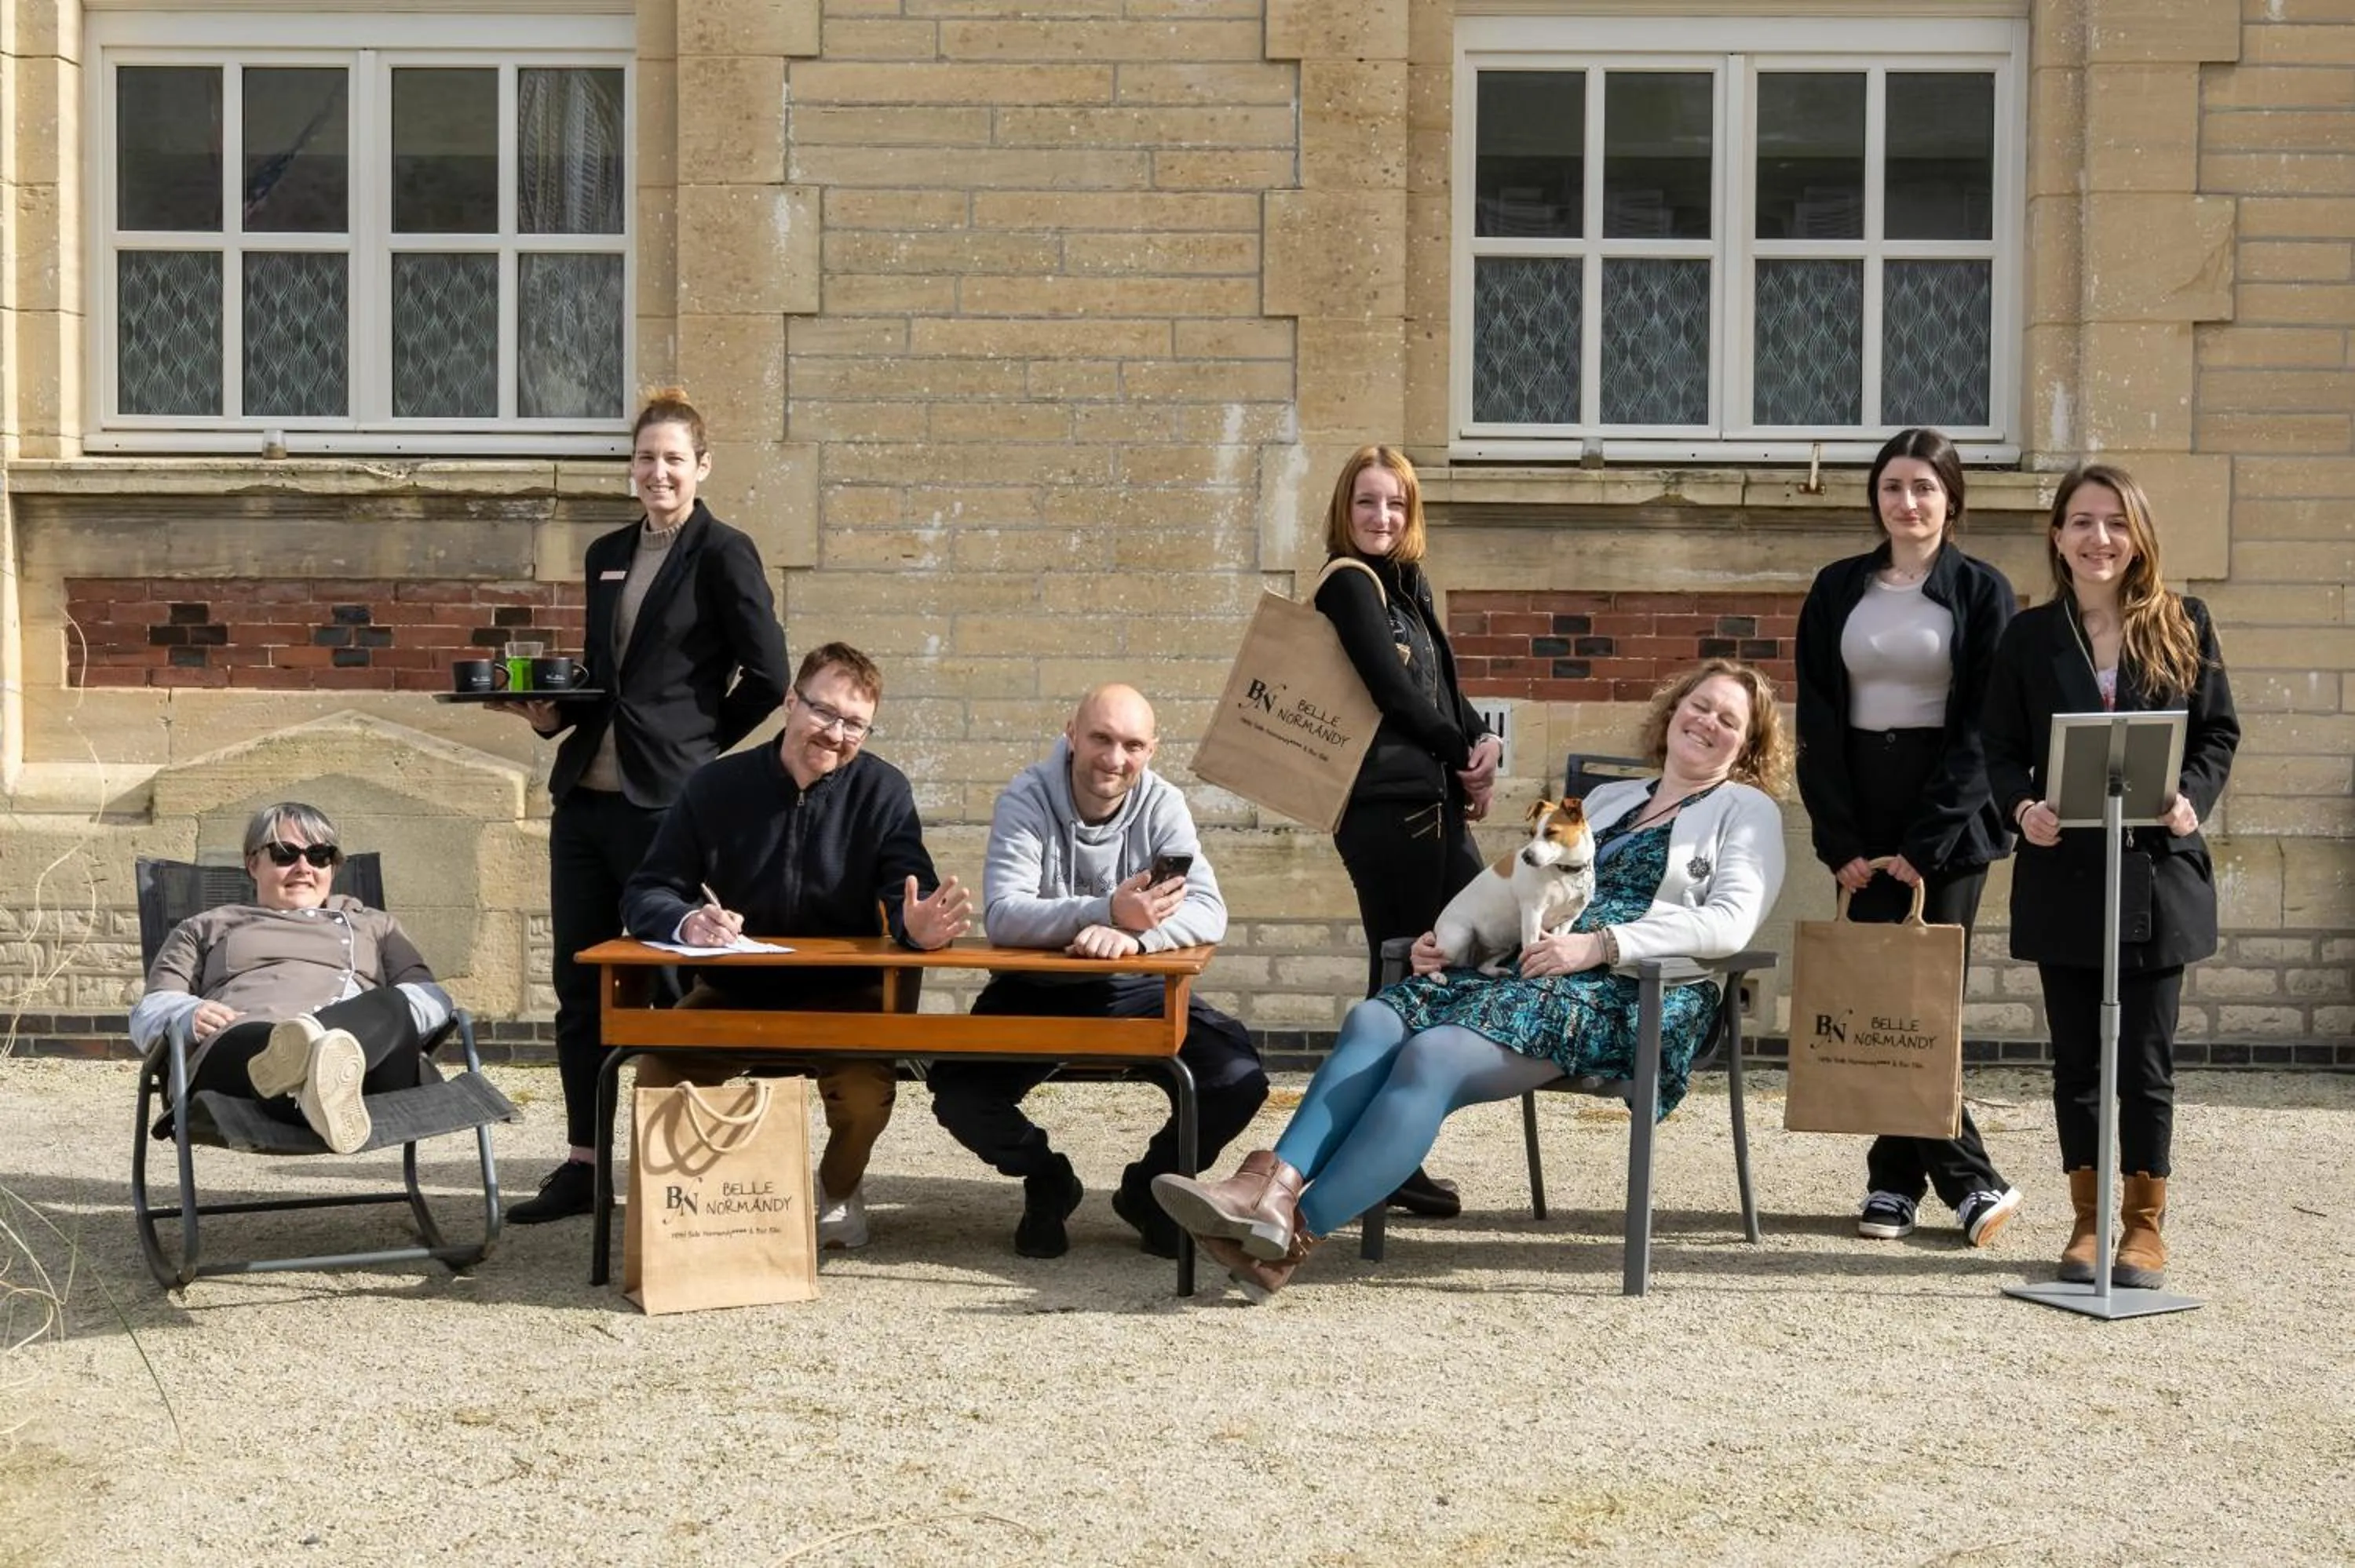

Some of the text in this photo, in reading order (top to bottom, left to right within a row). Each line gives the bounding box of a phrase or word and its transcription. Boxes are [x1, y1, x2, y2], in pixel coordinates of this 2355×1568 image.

[1298, 698, 1342, 727] BELLE
[1277, 708, 1351, 747] NORMANDY
[1871, 1016, 1919, 1032] BELLE
[1853, 1031, 1937, 1050] NORMANDY
[722, 1181, 773, 1196] BELLE
[706, 1195, 792, 1216] NORMANDY
